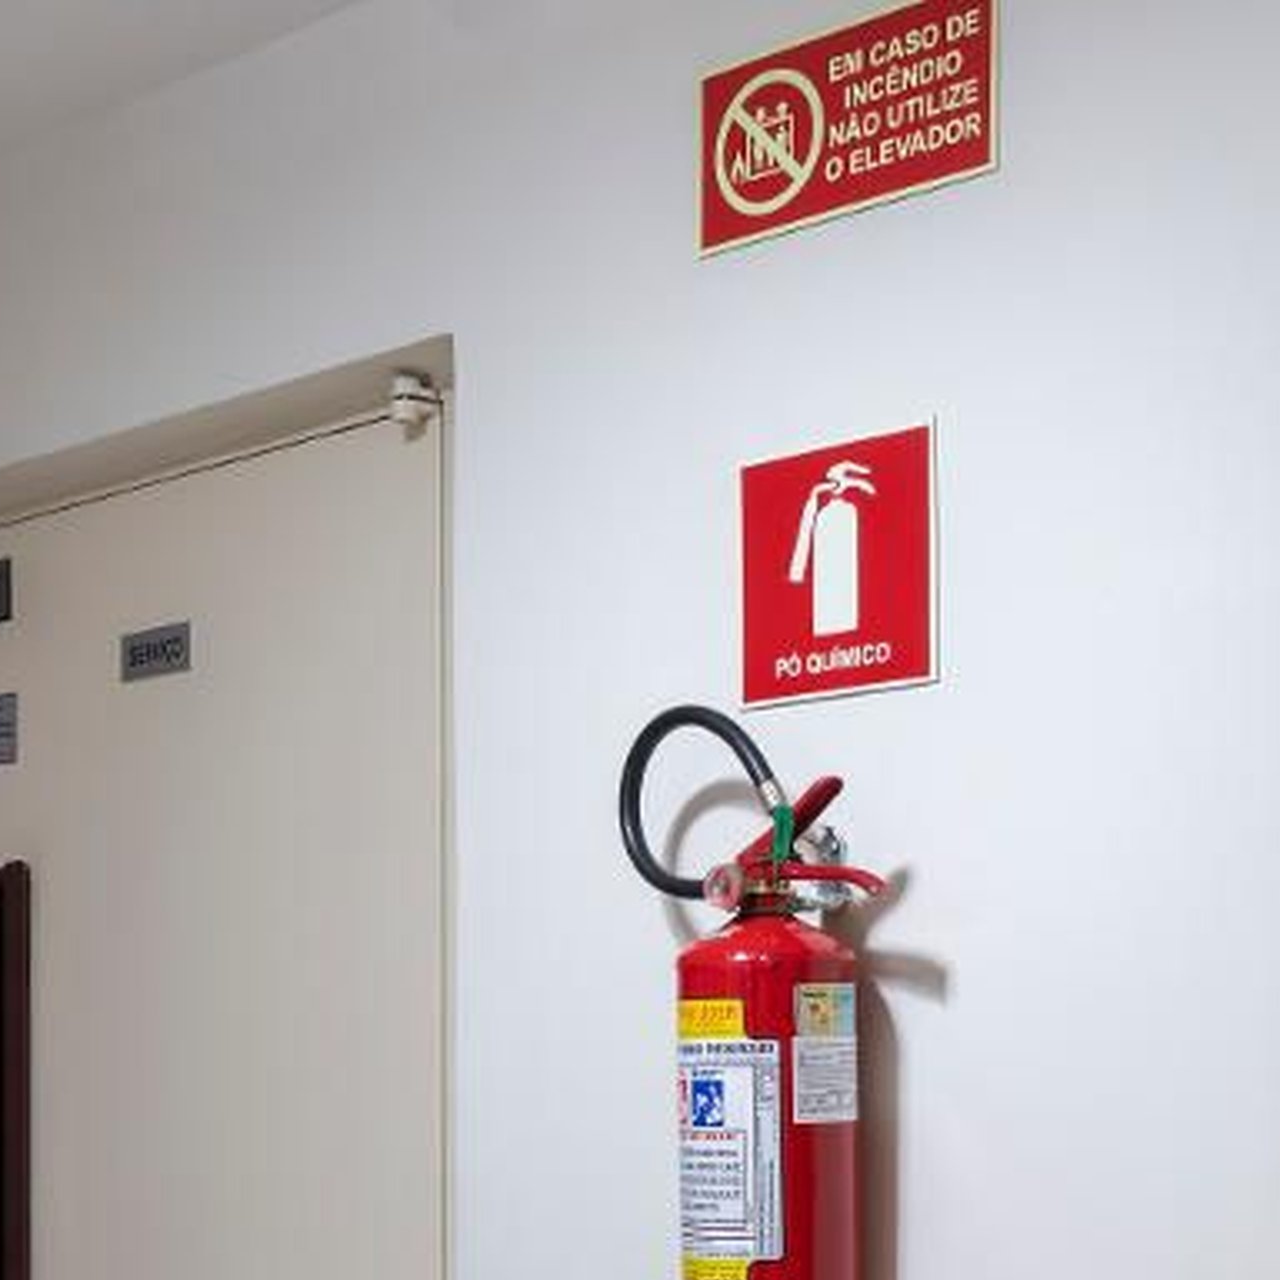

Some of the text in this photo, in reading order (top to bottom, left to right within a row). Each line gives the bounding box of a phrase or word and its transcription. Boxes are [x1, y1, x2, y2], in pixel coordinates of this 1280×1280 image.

[829, 9, 980, 82] EM CASO DE
[845, 51, 962, 108] INCÊNDIO
[825, 113, 981, 182] O ELEVADOR
[829, 79, 979, 148] NÃO UTILIZE
[775, 642, 891, 679] PÓ QUÍMICO
